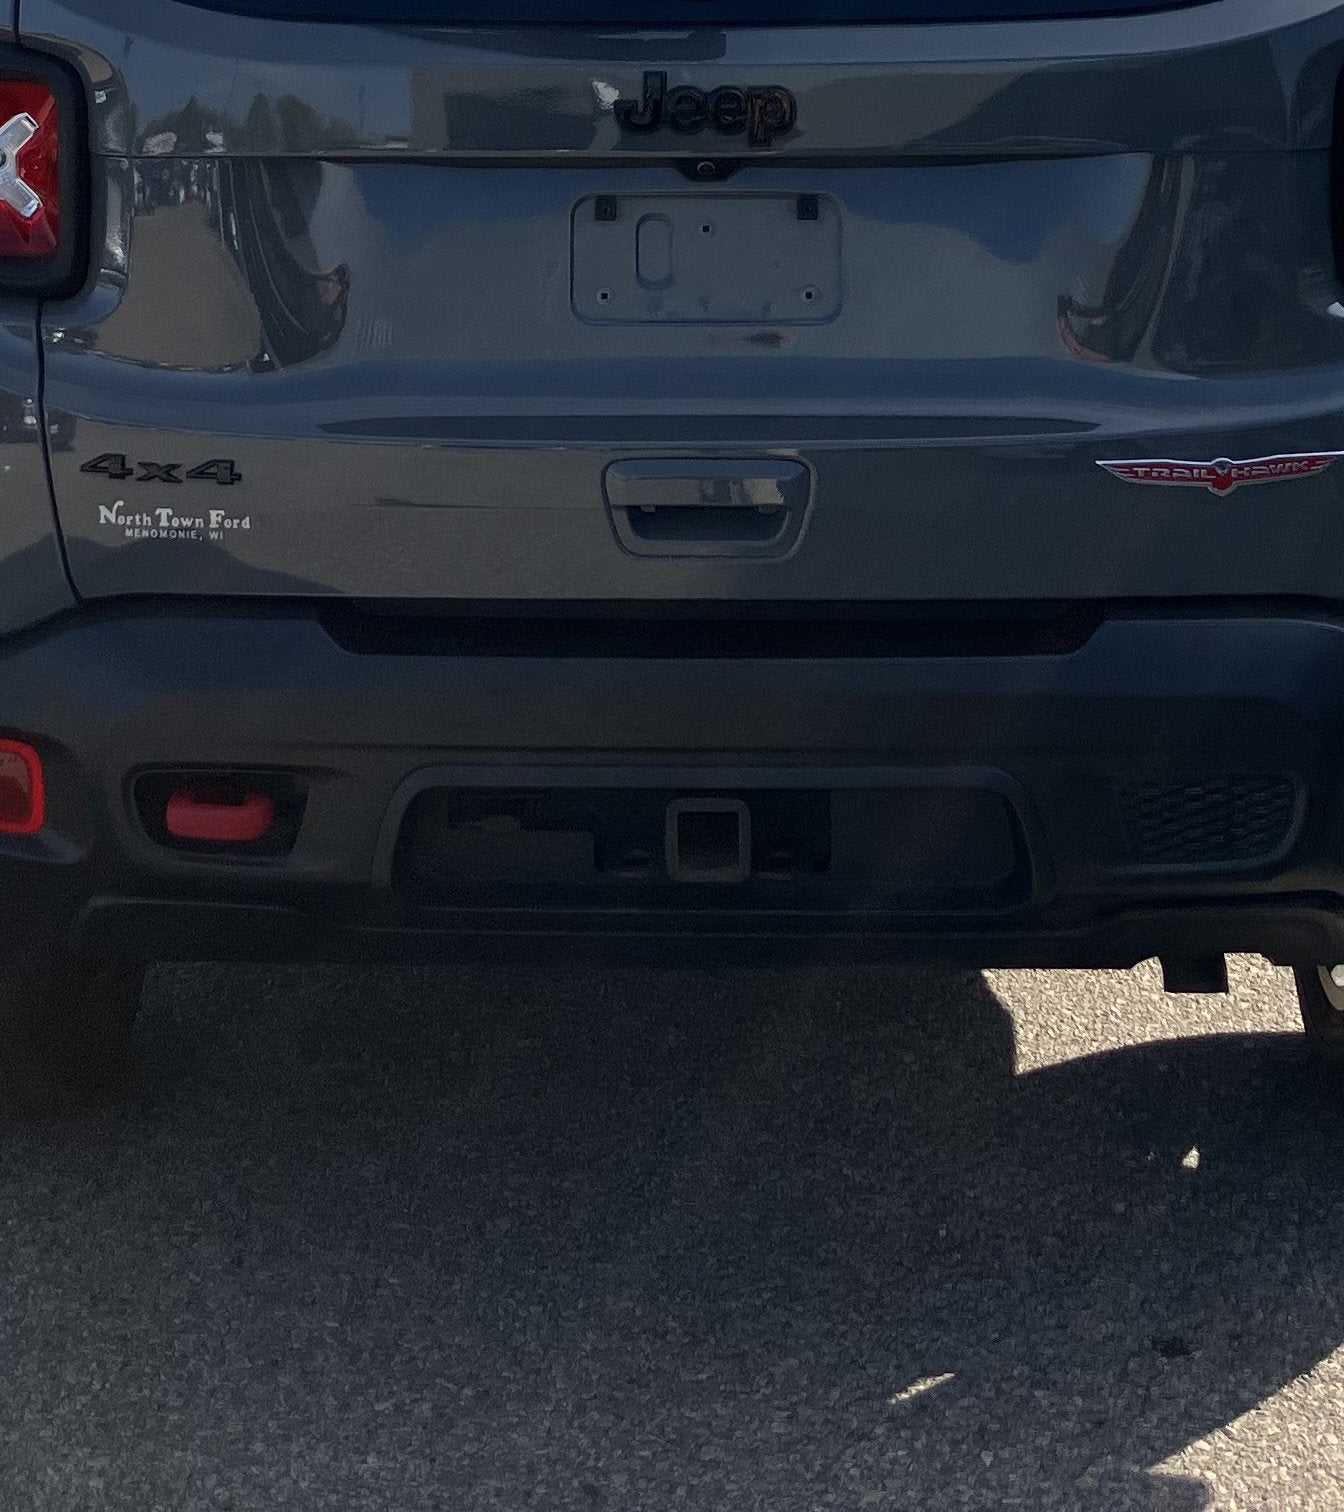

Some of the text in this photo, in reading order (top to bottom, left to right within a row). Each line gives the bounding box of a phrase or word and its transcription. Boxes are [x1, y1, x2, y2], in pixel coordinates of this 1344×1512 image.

[614, 71, 798, 147] Jeep
[79, 453, 243, 485] 4x4
[98, 500, 251, 529] North Town Ford
[124, 528, 224, 541] MENOMONIE, WI
